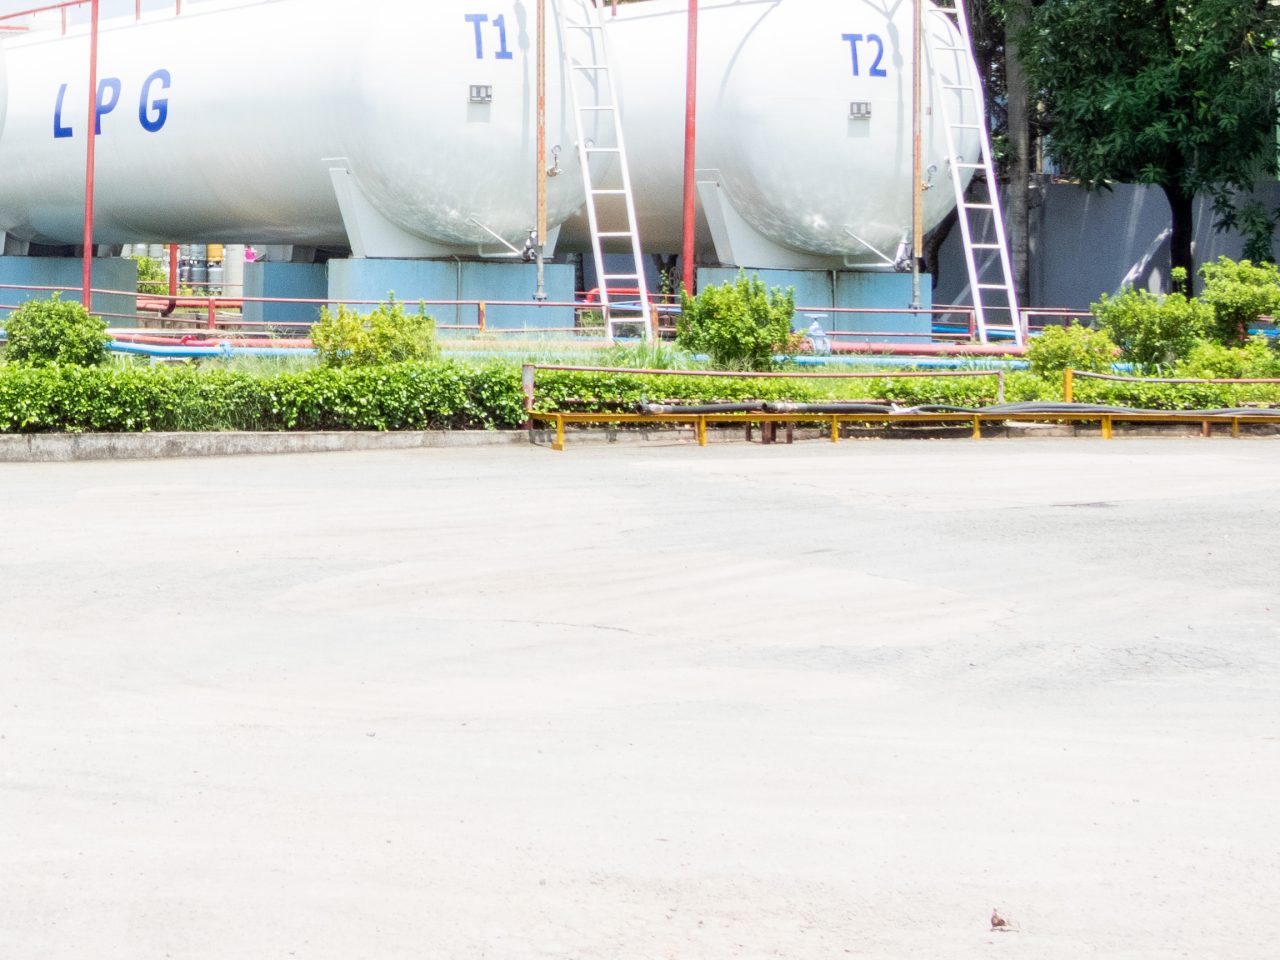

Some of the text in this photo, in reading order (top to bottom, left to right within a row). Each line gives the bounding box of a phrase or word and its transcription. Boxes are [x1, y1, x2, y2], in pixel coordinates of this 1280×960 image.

[464, 13, 513, 60] T1
[841, 33, 887, 77] T2
[53, 68, 171, 139] LPG
